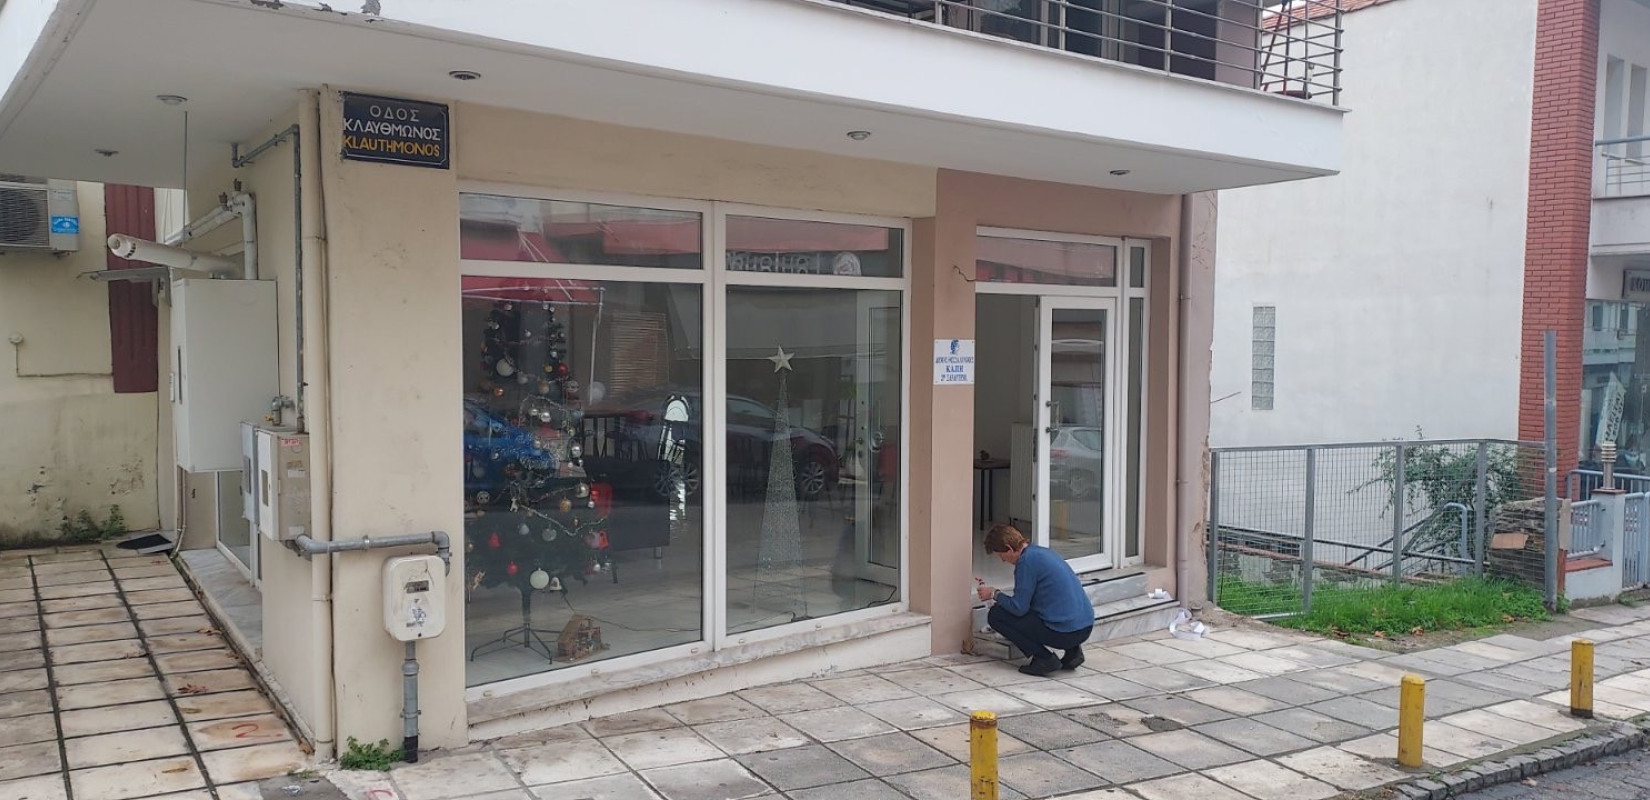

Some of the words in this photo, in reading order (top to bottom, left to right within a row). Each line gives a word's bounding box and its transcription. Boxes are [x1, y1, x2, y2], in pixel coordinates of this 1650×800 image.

[369, 105, 420, 122] ΟΔΟΣ
[343, 118, 441, 141] ΚΛΑΥΘΜΩΝΟΣ
[343, 135, 441, 157] KLAUTHMONOS
